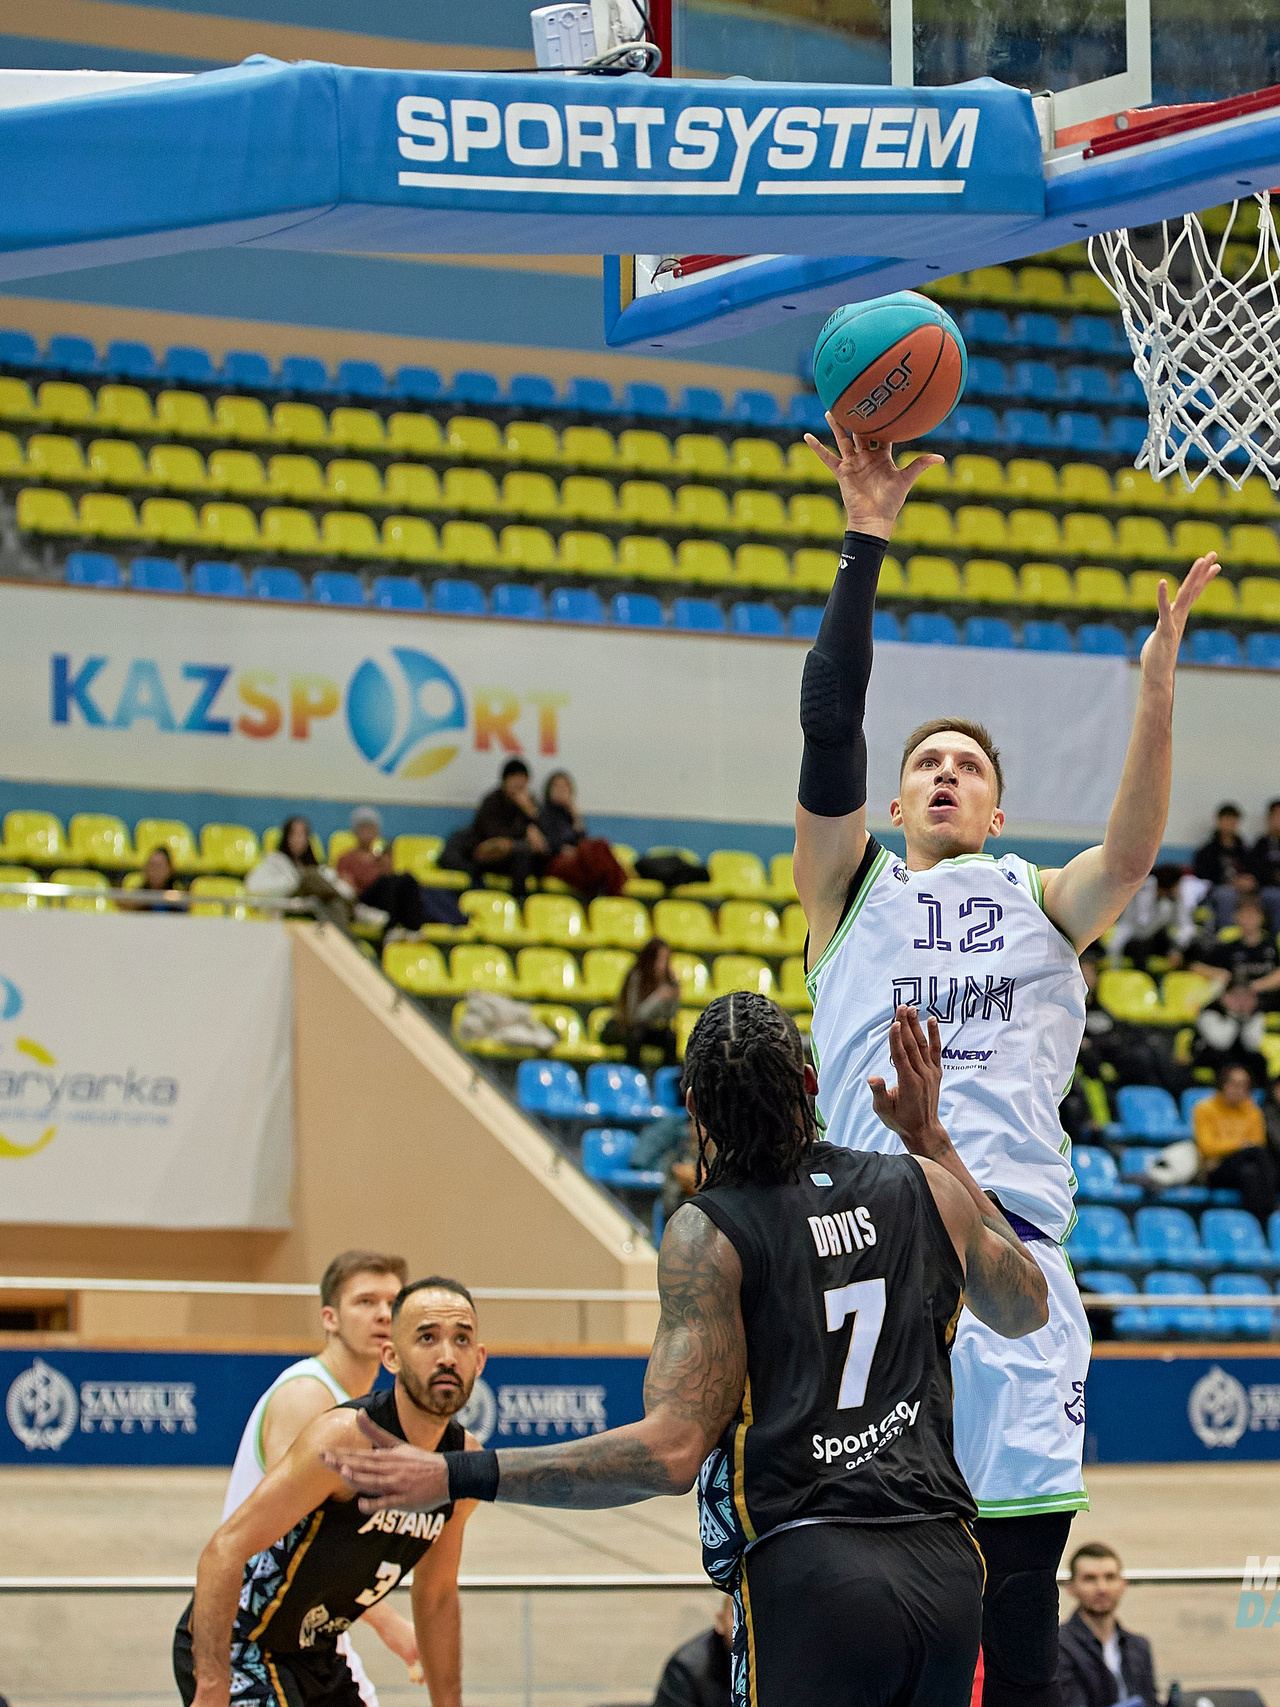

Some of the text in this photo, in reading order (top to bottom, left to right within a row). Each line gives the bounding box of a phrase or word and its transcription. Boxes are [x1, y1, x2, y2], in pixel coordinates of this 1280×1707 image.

[914, 893, 1004, 953] 12
[808, 1206, 877, 1257] DAVIS
[824, 1278, 887, 1410] 7
[355, 1561, 401, 1606] 3
